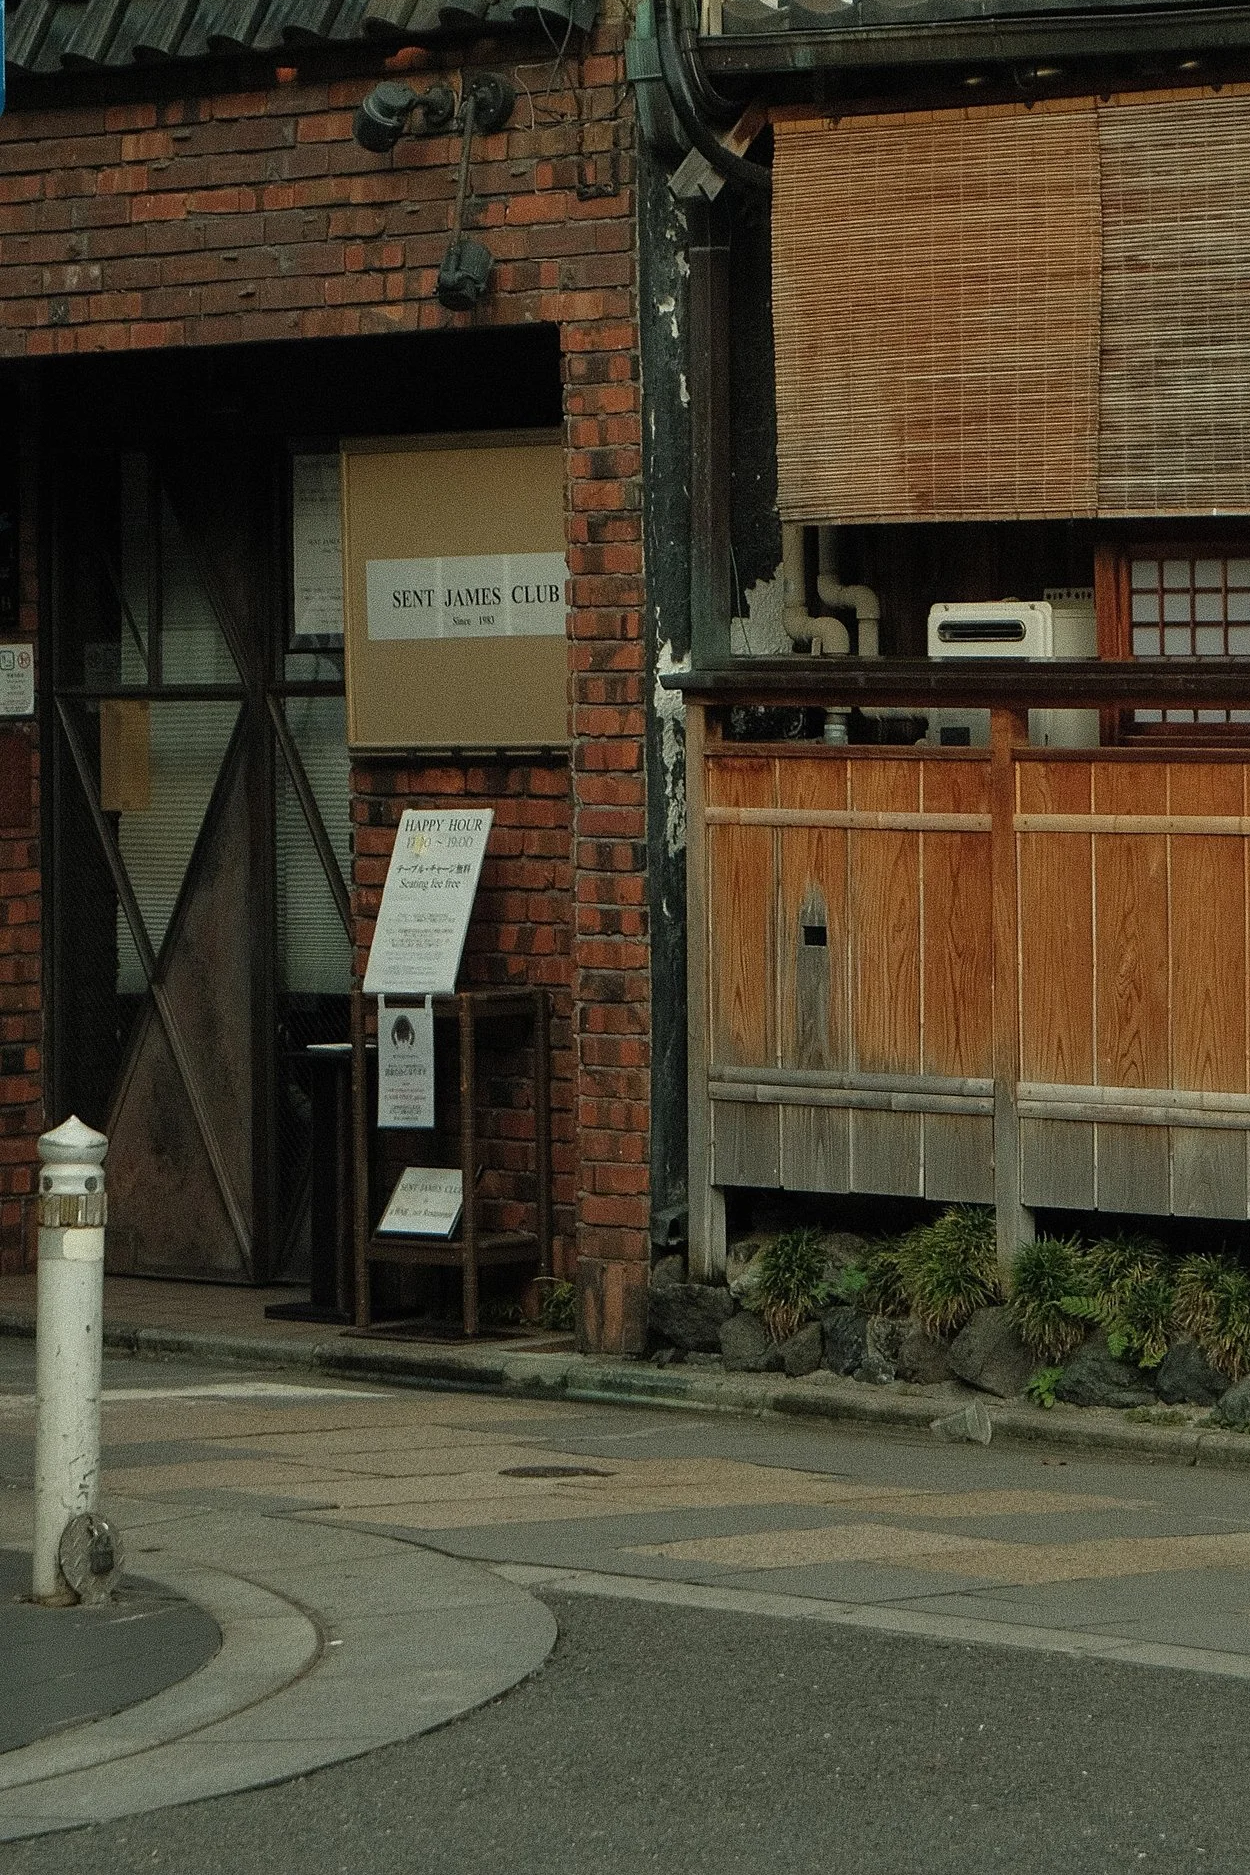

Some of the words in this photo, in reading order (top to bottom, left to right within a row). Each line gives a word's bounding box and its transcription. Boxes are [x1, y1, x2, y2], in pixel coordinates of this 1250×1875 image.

[392, 589, 435, 608] SENT
[444, 587, 502, 607] JAMES
[511, 584, 560, 604] CLUB
[452, 616, 471, 626] Since
[405, 819, 444, 832] HAPPY
[448, 818, 483, 832] HOUR
